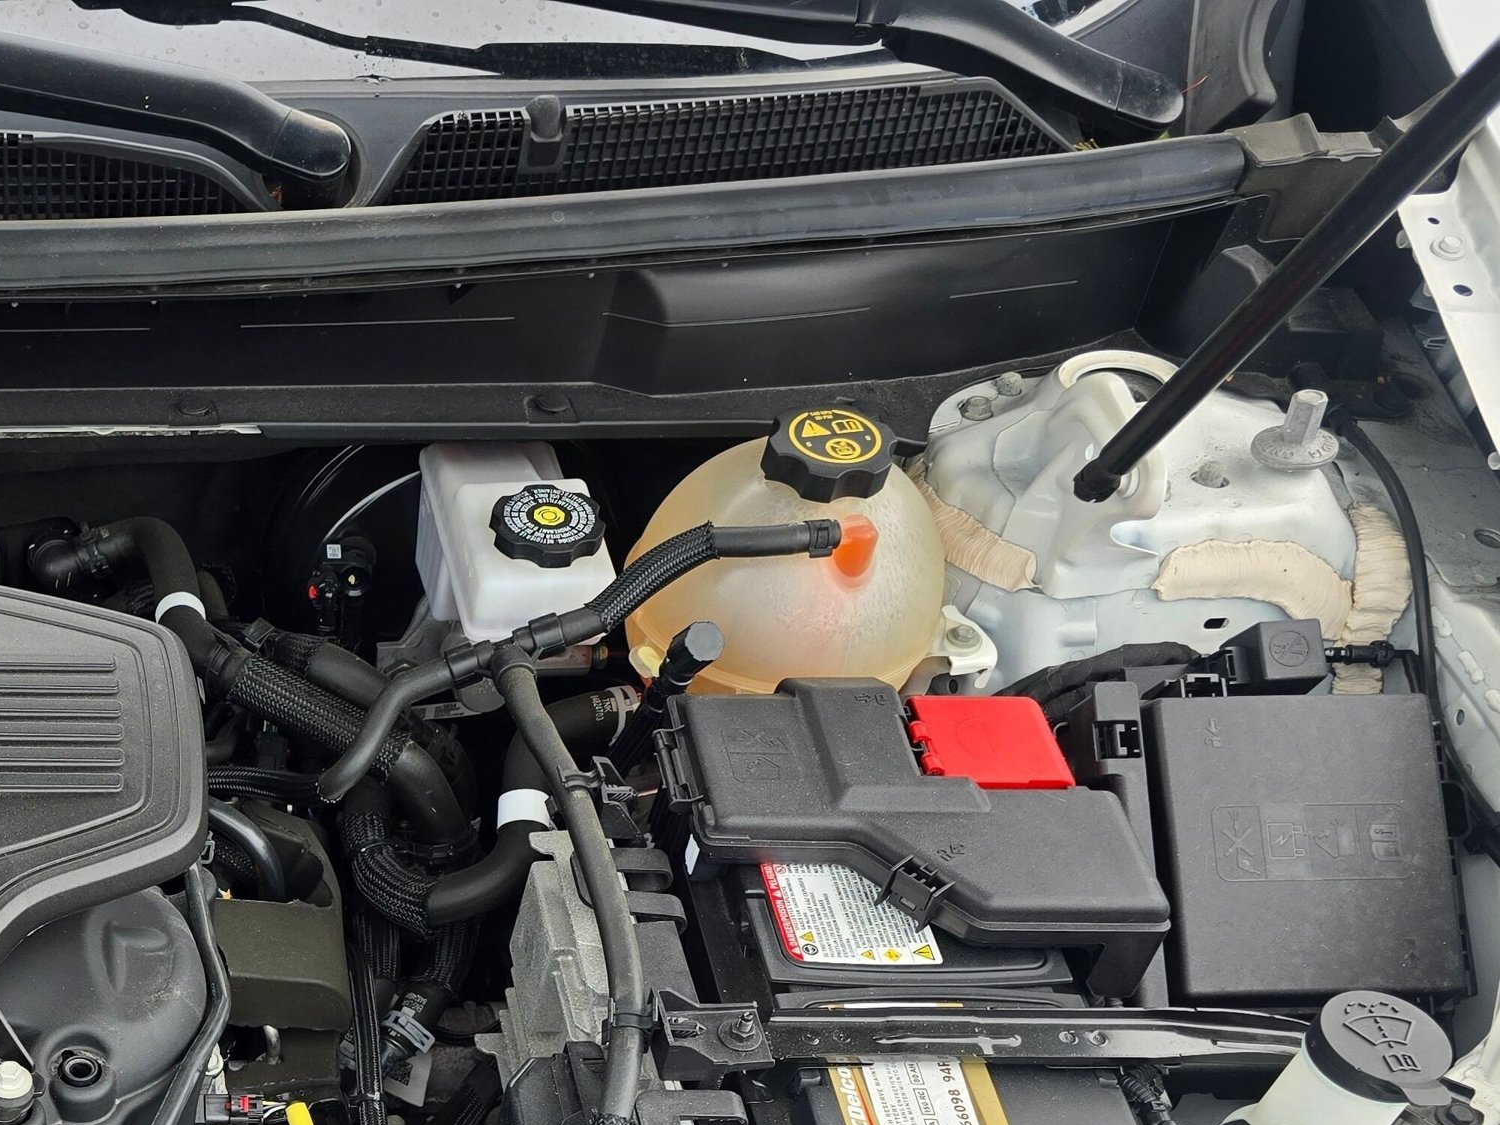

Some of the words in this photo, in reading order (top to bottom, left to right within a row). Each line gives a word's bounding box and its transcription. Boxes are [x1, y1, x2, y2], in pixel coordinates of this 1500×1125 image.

[909, 1064, 917, 1073] AH
[918, 1091, 926, 1100] RC
[877, 1089, 891, 1117] RESERVE
[922, 1102, 931, 1112] 150
